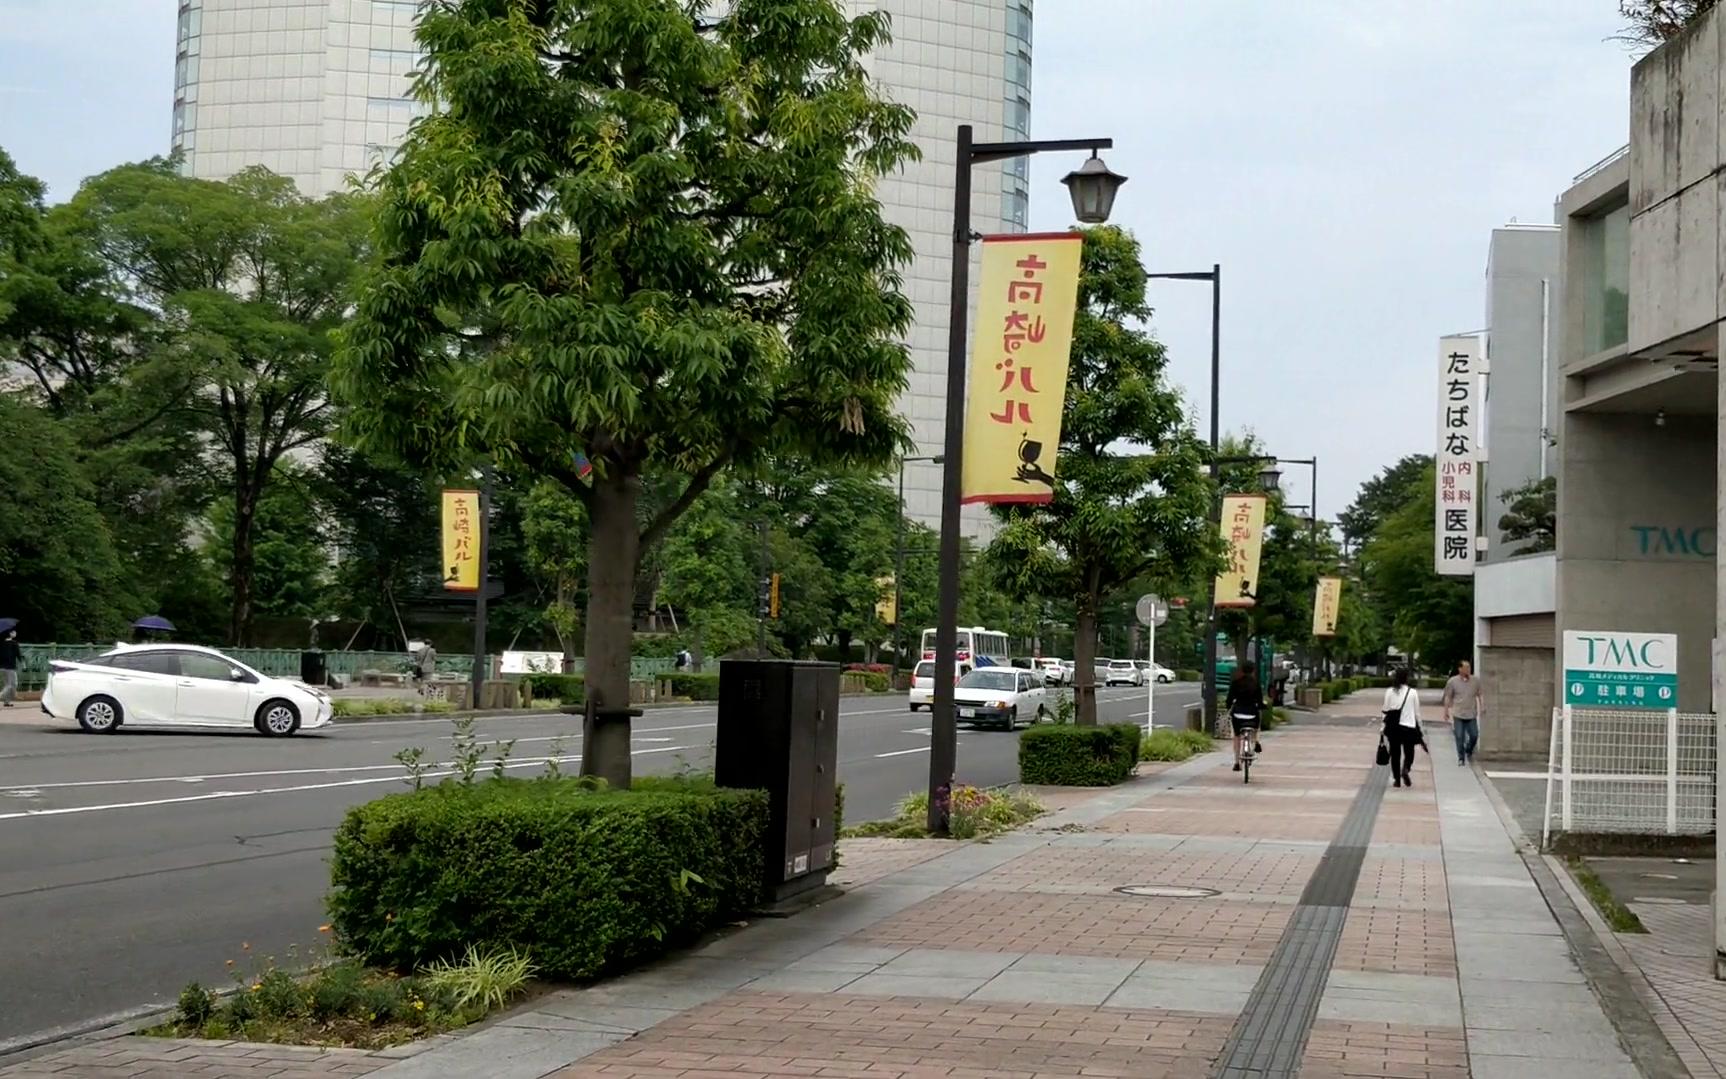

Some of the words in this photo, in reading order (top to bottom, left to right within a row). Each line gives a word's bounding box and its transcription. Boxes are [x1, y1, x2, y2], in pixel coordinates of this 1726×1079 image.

[1445, 352, 1469, 456] たちばな
[1442, 462, 1455, 503] 小児科
[1458, 462, 1471, 503] 内科
[453, 498, 472, 561] 高崎バル
[1444, 509, 1467, 560] 医院
[1630, 526, 1717, 557] TMC
[1576, 637, 1664, 668] TMC
